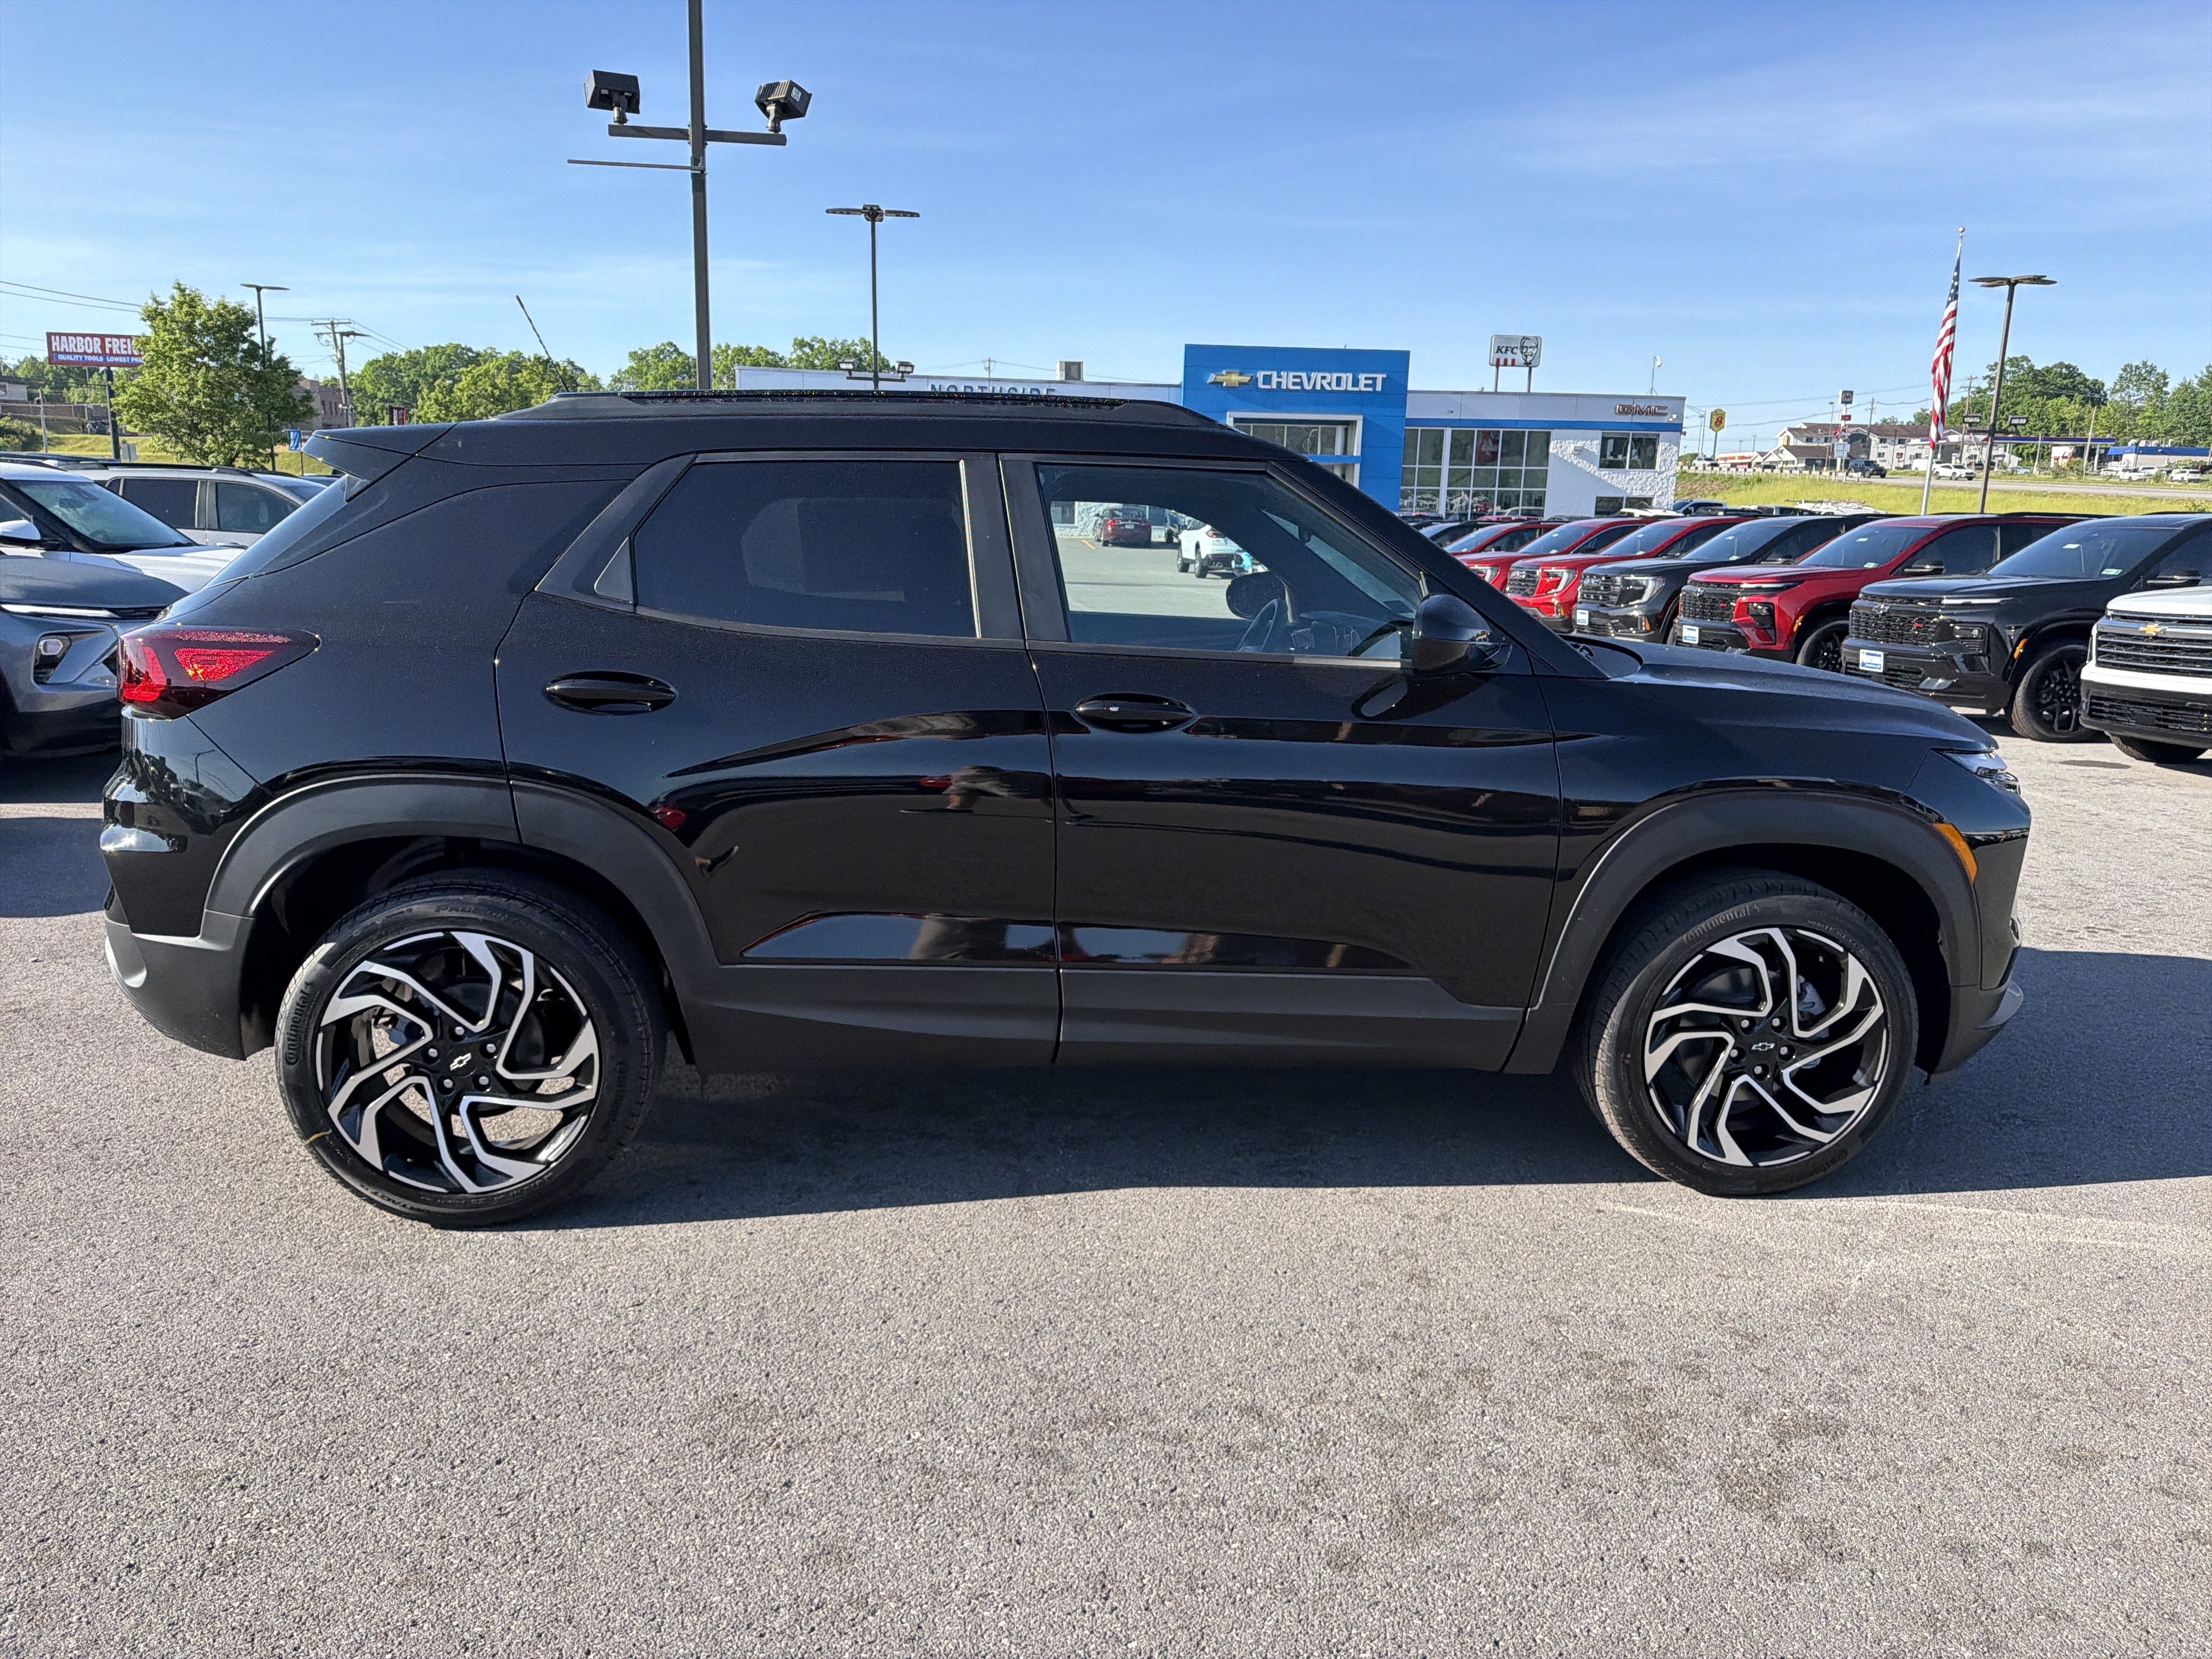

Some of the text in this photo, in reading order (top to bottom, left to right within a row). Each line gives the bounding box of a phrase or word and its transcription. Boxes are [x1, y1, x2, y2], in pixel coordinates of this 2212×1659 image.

[51, 335, 102, 354] HARBOR
[1495, 345, 1519, 354] KFC
[1257, 370, 1387, 392] CHEVROLET
[1616, 404, 1668, 416] GMC
[1714, 416, 1724, 427] 8
[1683, 905, 1751, 944] Continental
[285, 988, 311, 1065] Continental
